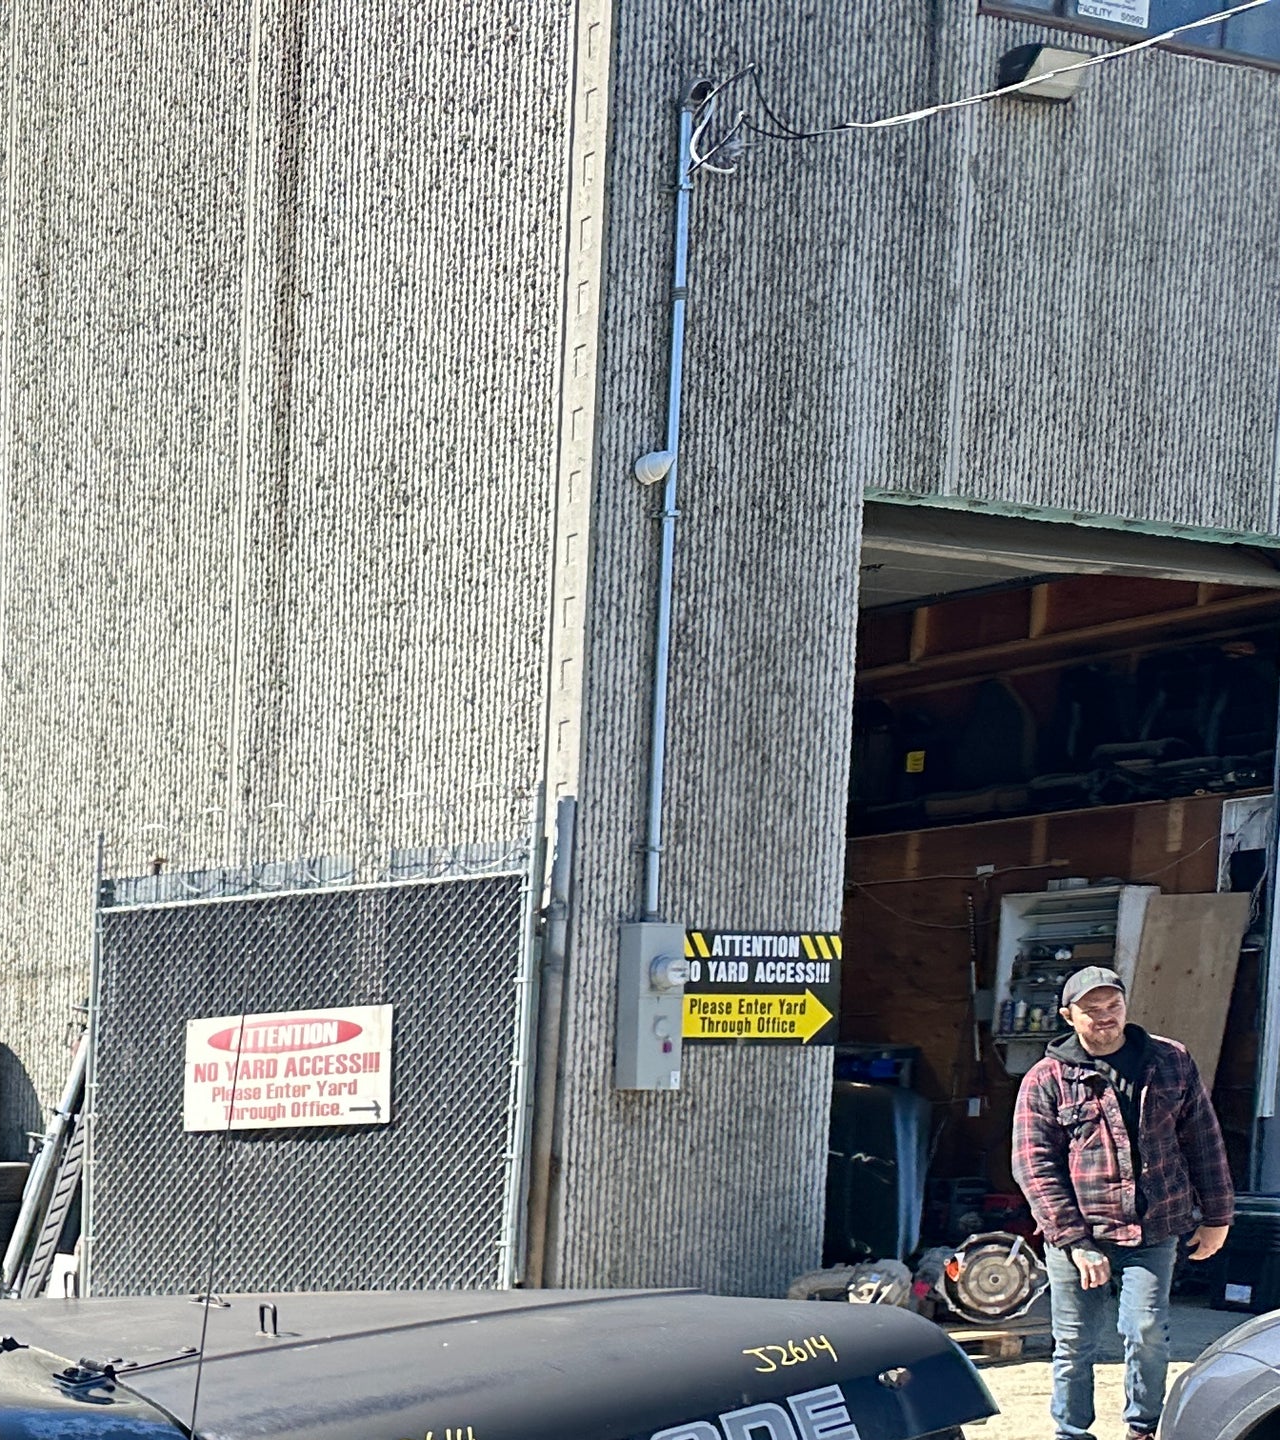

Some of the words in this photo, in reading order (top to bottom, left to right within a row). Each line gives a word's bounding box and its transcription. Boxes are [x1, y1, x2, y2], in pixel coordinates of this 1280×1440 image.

[712, 935, 800, 957] ATTENTION
[708, 961, 748, 983] YARD
[755, 962, 830, 983] ACCESS!!!
[690, 998, 732, 1015] Please
[739, 998, 772, 1015] Enter
[779, 998, 806, 1015] Yard
[229, 1021, 339, 1050] ATTENTION
[700, 1018, 751, 1034] Through
[757, 1018, 795, 1033] Office
[194, 1062, 218, 1083] NO
[225, 1058, 278, 1081] YARD
[284, 1052, 381, 1077] ACCESS!!!
[212, 1086, 261, 1102] Please
[267, 1083, 311, 1100] Enter
[317, 1079, 358, 1097] Yard
[224, 1102, 286, 1121] Through
[291, 1101, 344, 1118] Office.
[743, 1335, 839, 1374] J2614
